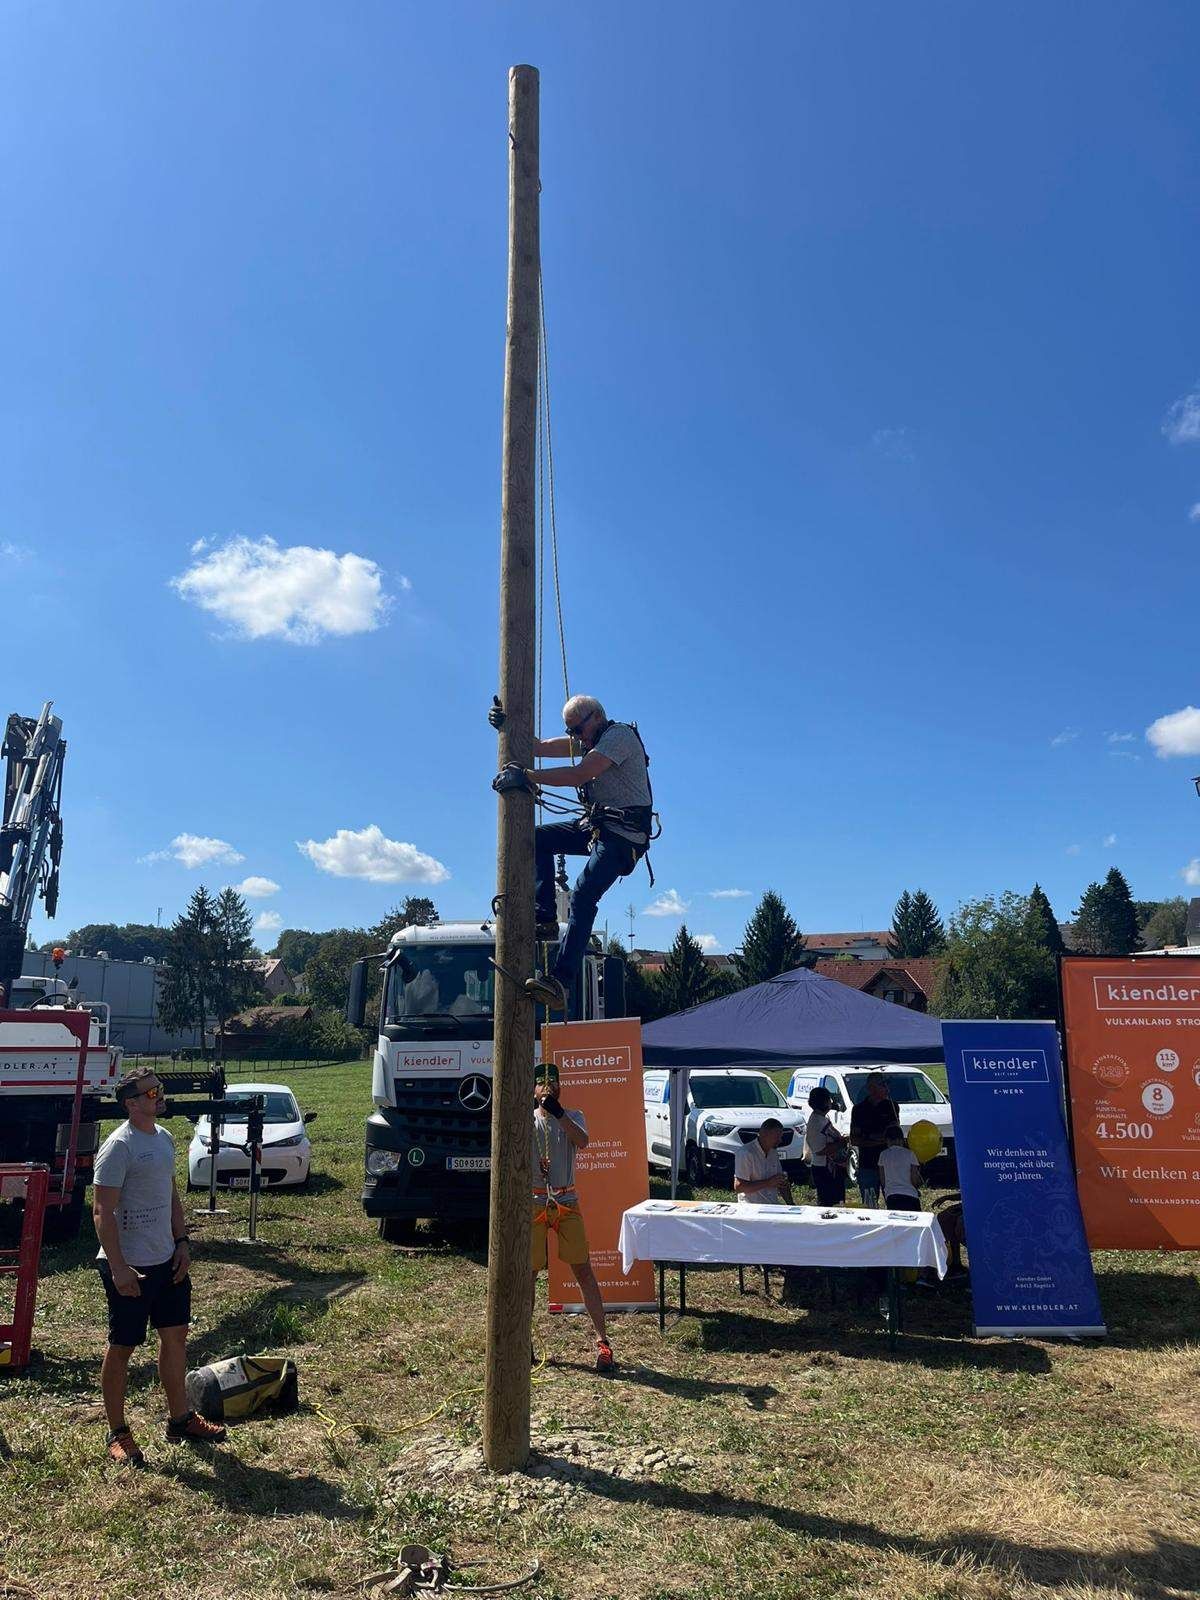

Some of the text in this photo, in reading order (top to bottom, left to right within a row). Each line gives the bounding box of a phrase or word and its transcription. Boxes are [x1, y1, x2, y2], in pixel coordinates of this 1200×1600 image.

[1107, 984, 1200, 1001] kiendler
[1105, 1018, 1200, 1026] VULKANLAND STRO
[404, 1056, 454, 1066] kiendler
[562, 1054, 623, 1068] kiendler
[1160, 1053, 1176, 1061] 115
[0, 1062, 57, 1070] DLER.AT
[973, 1057, 1038, 1070] kiendler
[559, 1078, 603, 1086] VULKANLAND
[1152, 1087, 1163, 1101] 8
[1096, 1122, 1153, 1139] 4.500
[586, 1140, 611, 1148] enken
[575, 1152, 595, 1160] rgen,
[610, 1149, 628, 1158] über
[987, 1147, 1048, 1157] Wir denken an
[576, 1161, 617, 1171] 300 Jahren.
[983, 1159, 1056, 1171] morgen, seit über
[997, 1171, 1044, 1182] 300 Jahren.
[1100, 1165, 1128, 1178] Wir
[1132, 1166, 1188, 1180] denken
[1128, 1197, 1200, 1206] VULKANLANDSTRO
[562, 1280, 641, 1288] VULKNDSTROM.AT
